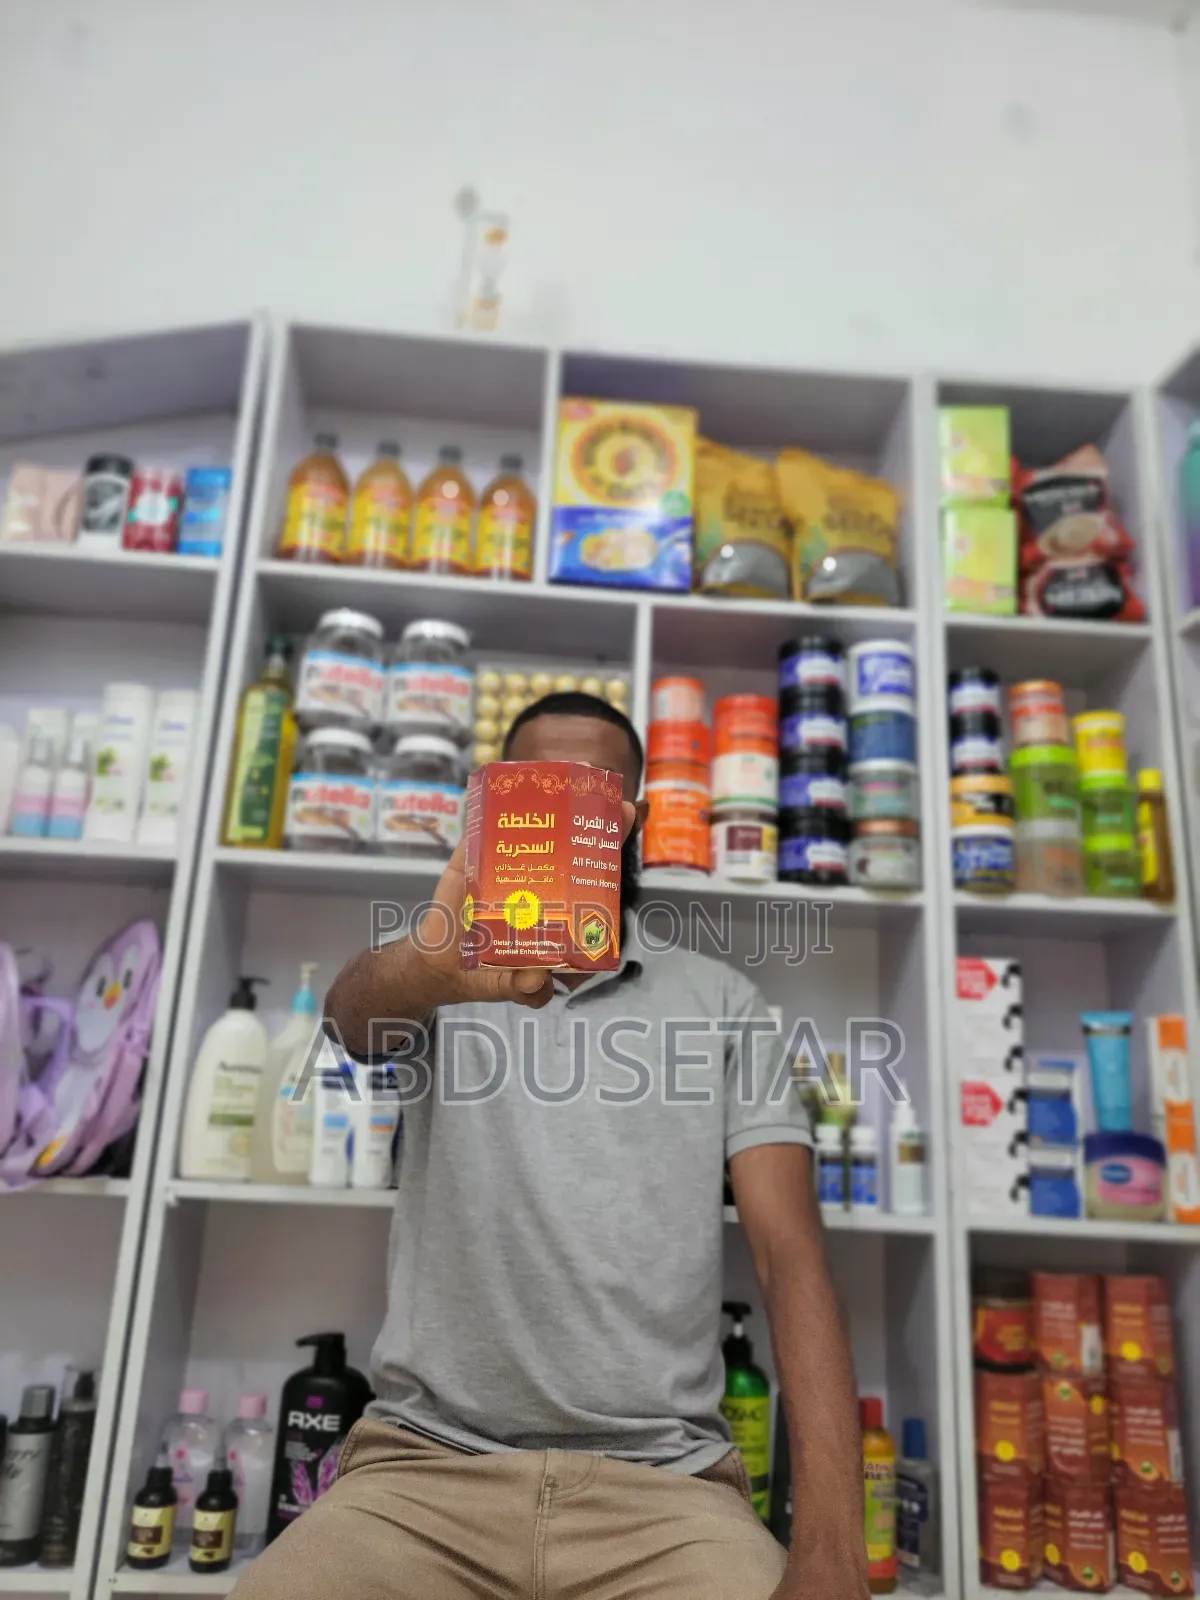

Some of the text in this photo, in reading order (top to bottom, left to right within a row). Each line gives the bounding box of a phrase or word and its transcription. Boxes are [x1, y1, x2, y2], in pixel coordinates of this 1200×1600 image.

[497, 812, 555, 829] الخلطة
[573, 814, 619, 834] كل الثمرات
[496, 840, 554, 858] السحرية
[571, 833, 620, 850] للعسل اليمني
[494, 863, 555, 873] مكمل غذائي
[572, 856, 618, 872] All Fruits for
[495, 874, 554, 885] فاتح للشهية
[571, 875, 619, 892] Yemeni Honey
[493, 939, 513, 947] Dietary
[287, 1409, 341, 1432] AXE
